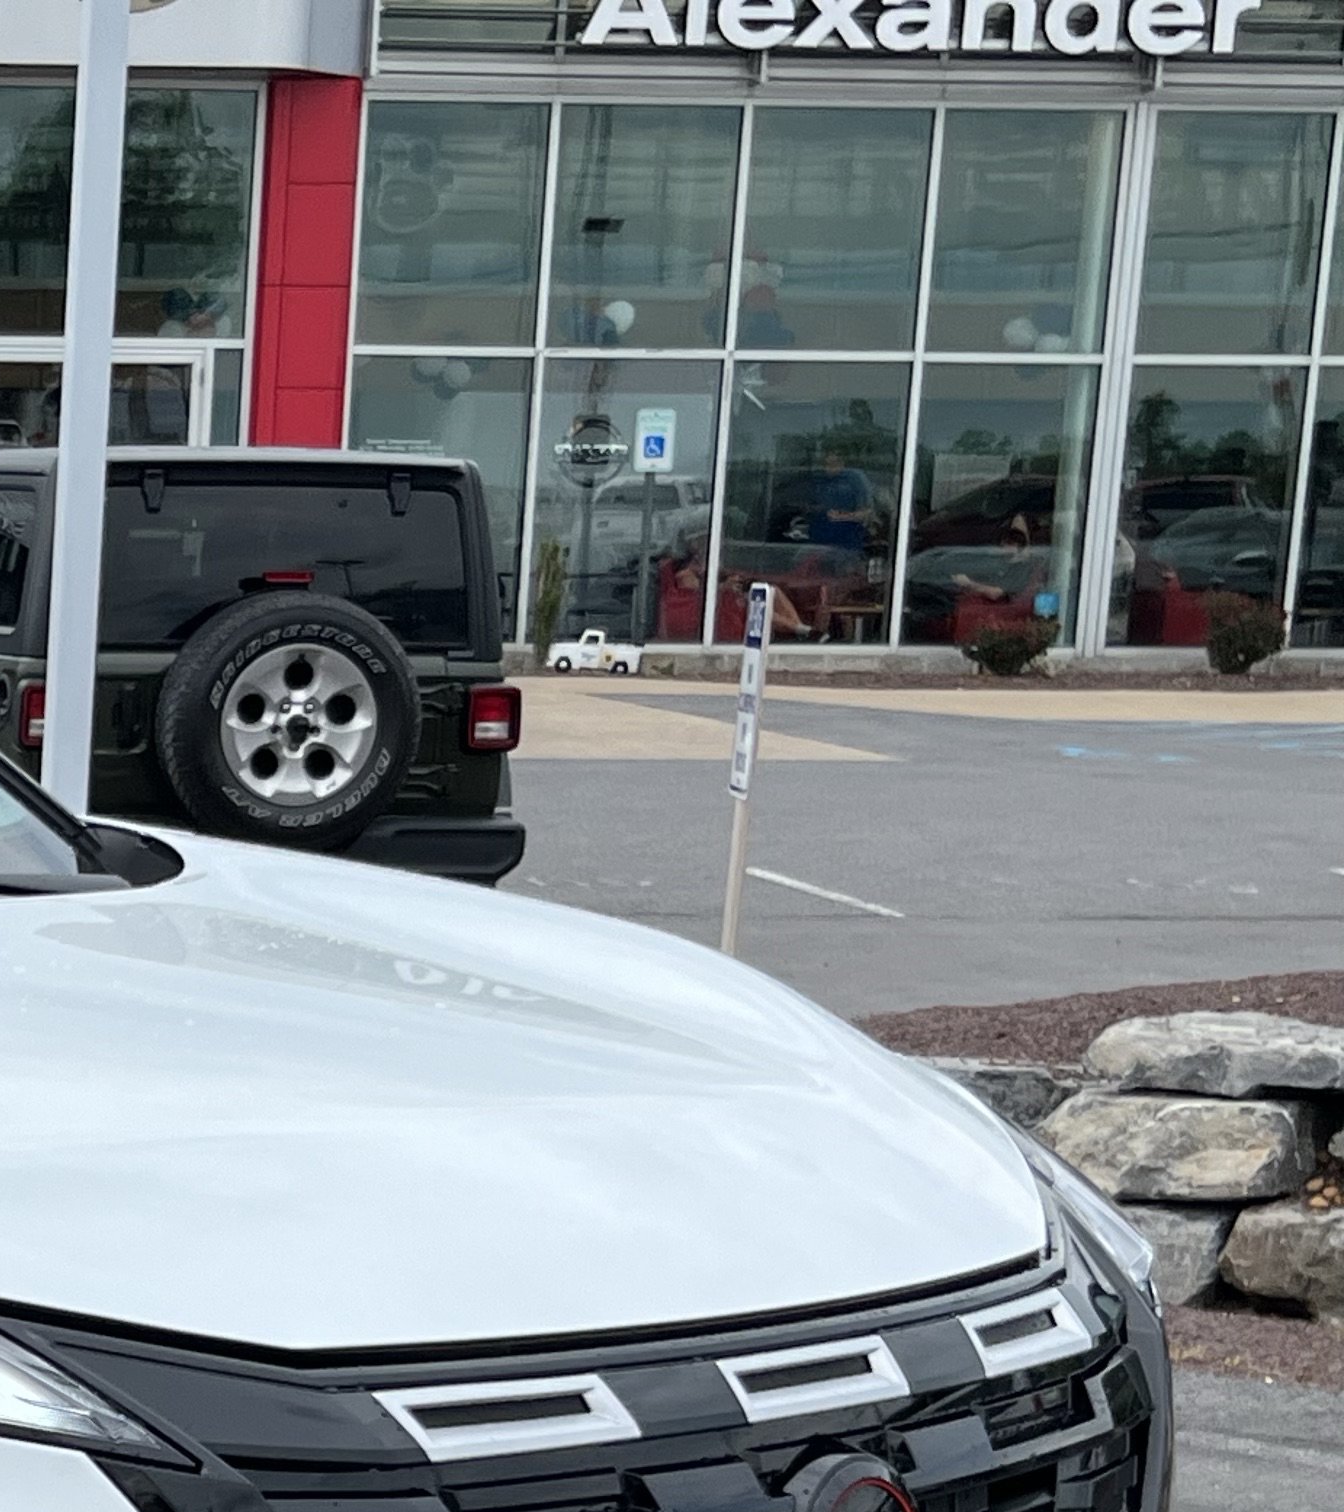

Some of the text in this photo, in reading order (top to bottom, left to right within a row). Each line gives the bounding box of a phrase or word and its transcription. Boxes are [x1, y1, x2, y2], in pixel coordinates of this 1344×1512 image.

[580, 0, 1263, 55] Alexander
[210, 624, 386, 709] BRIDGESTONE
[279, 748, 391, 827] DUELER
